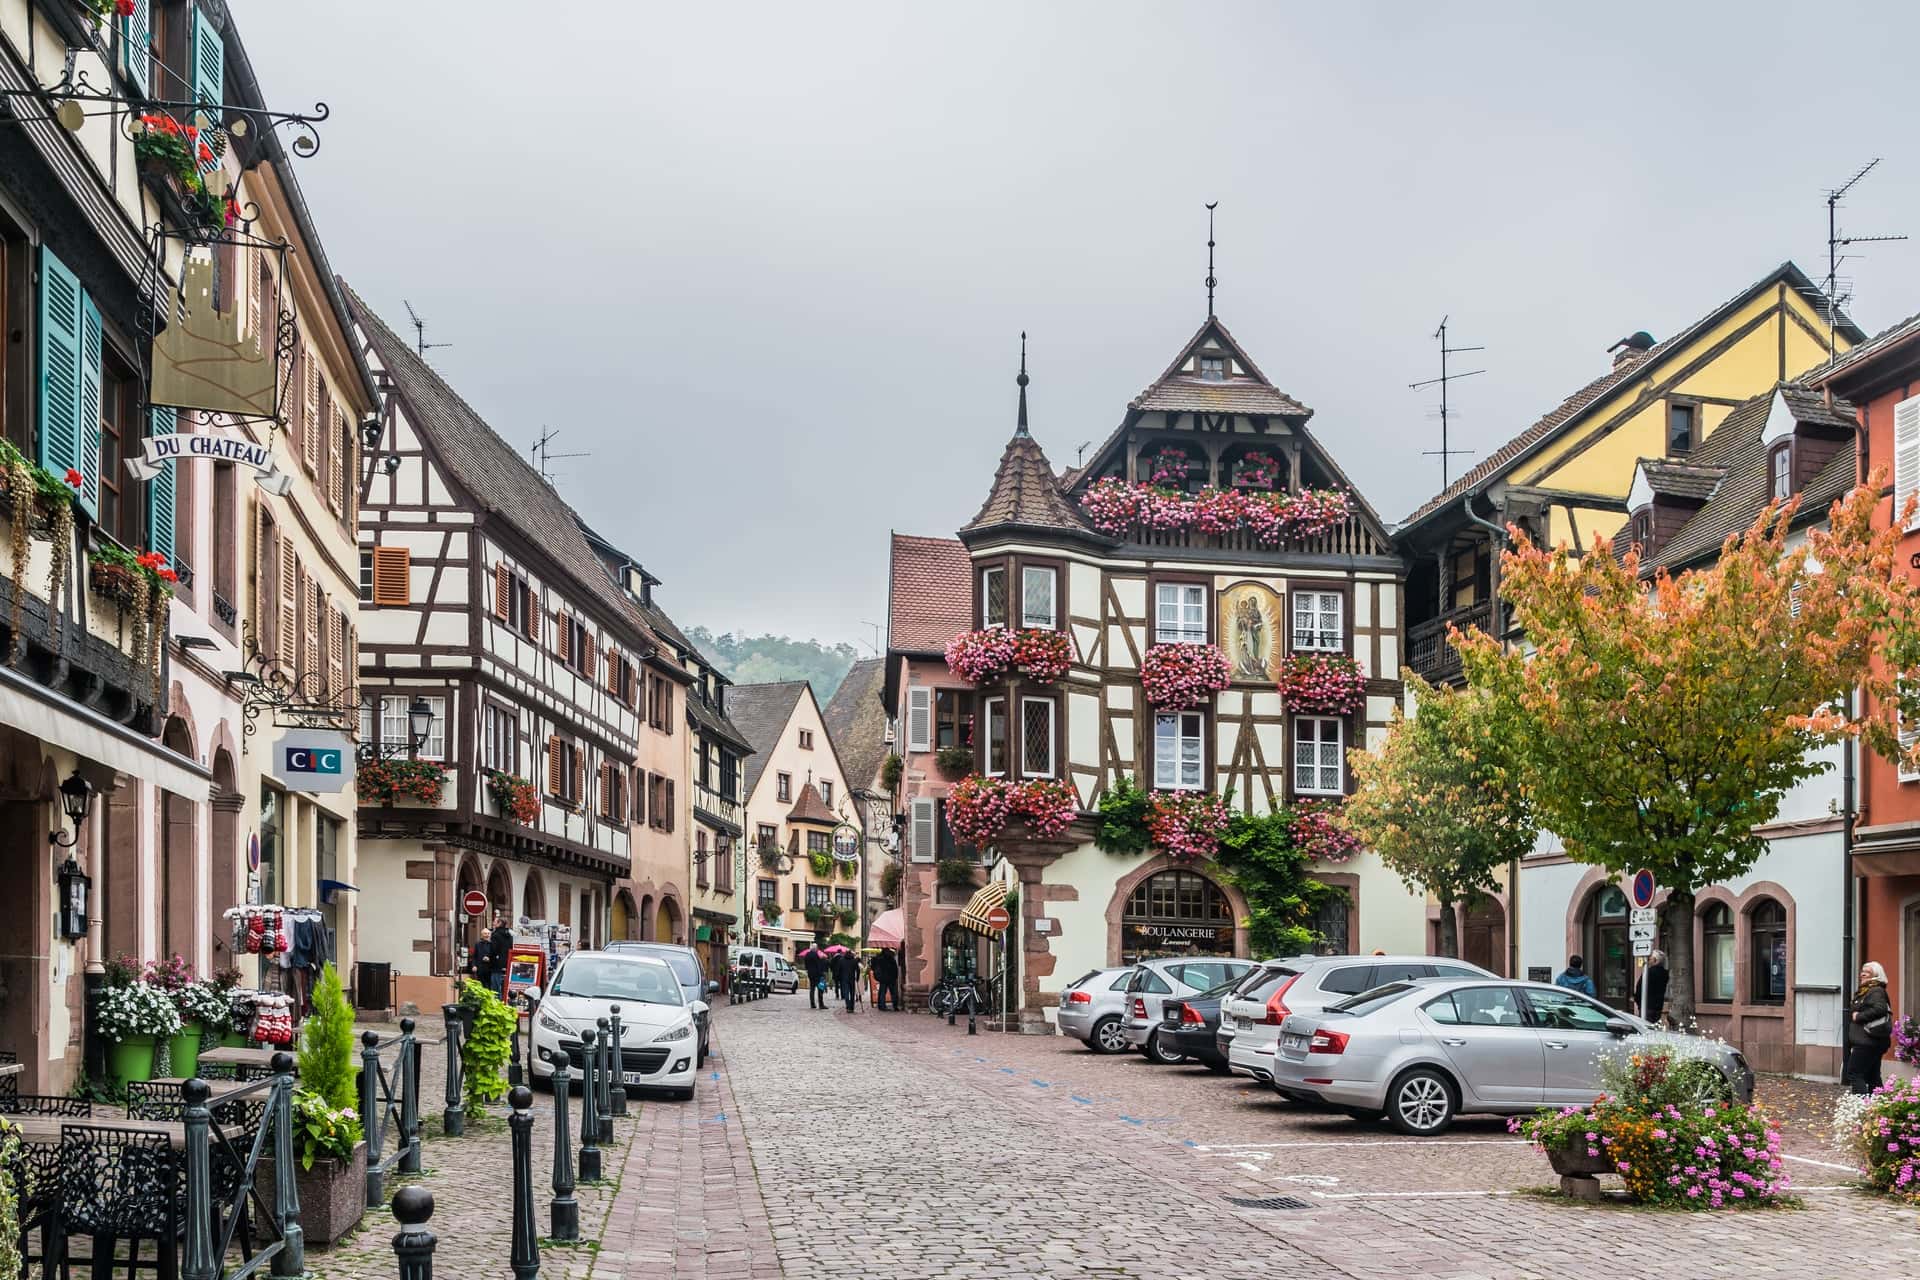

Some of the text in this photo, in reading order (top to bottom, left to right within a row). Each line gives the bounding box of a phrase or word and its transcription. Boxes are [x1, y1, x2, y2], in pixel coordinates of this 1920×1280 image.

[155, 436, 268, 466] DU CHATEAU
[291, 752, 336, 769] CIC
[1141, 925, 1215, 938] BOULANGERIE
